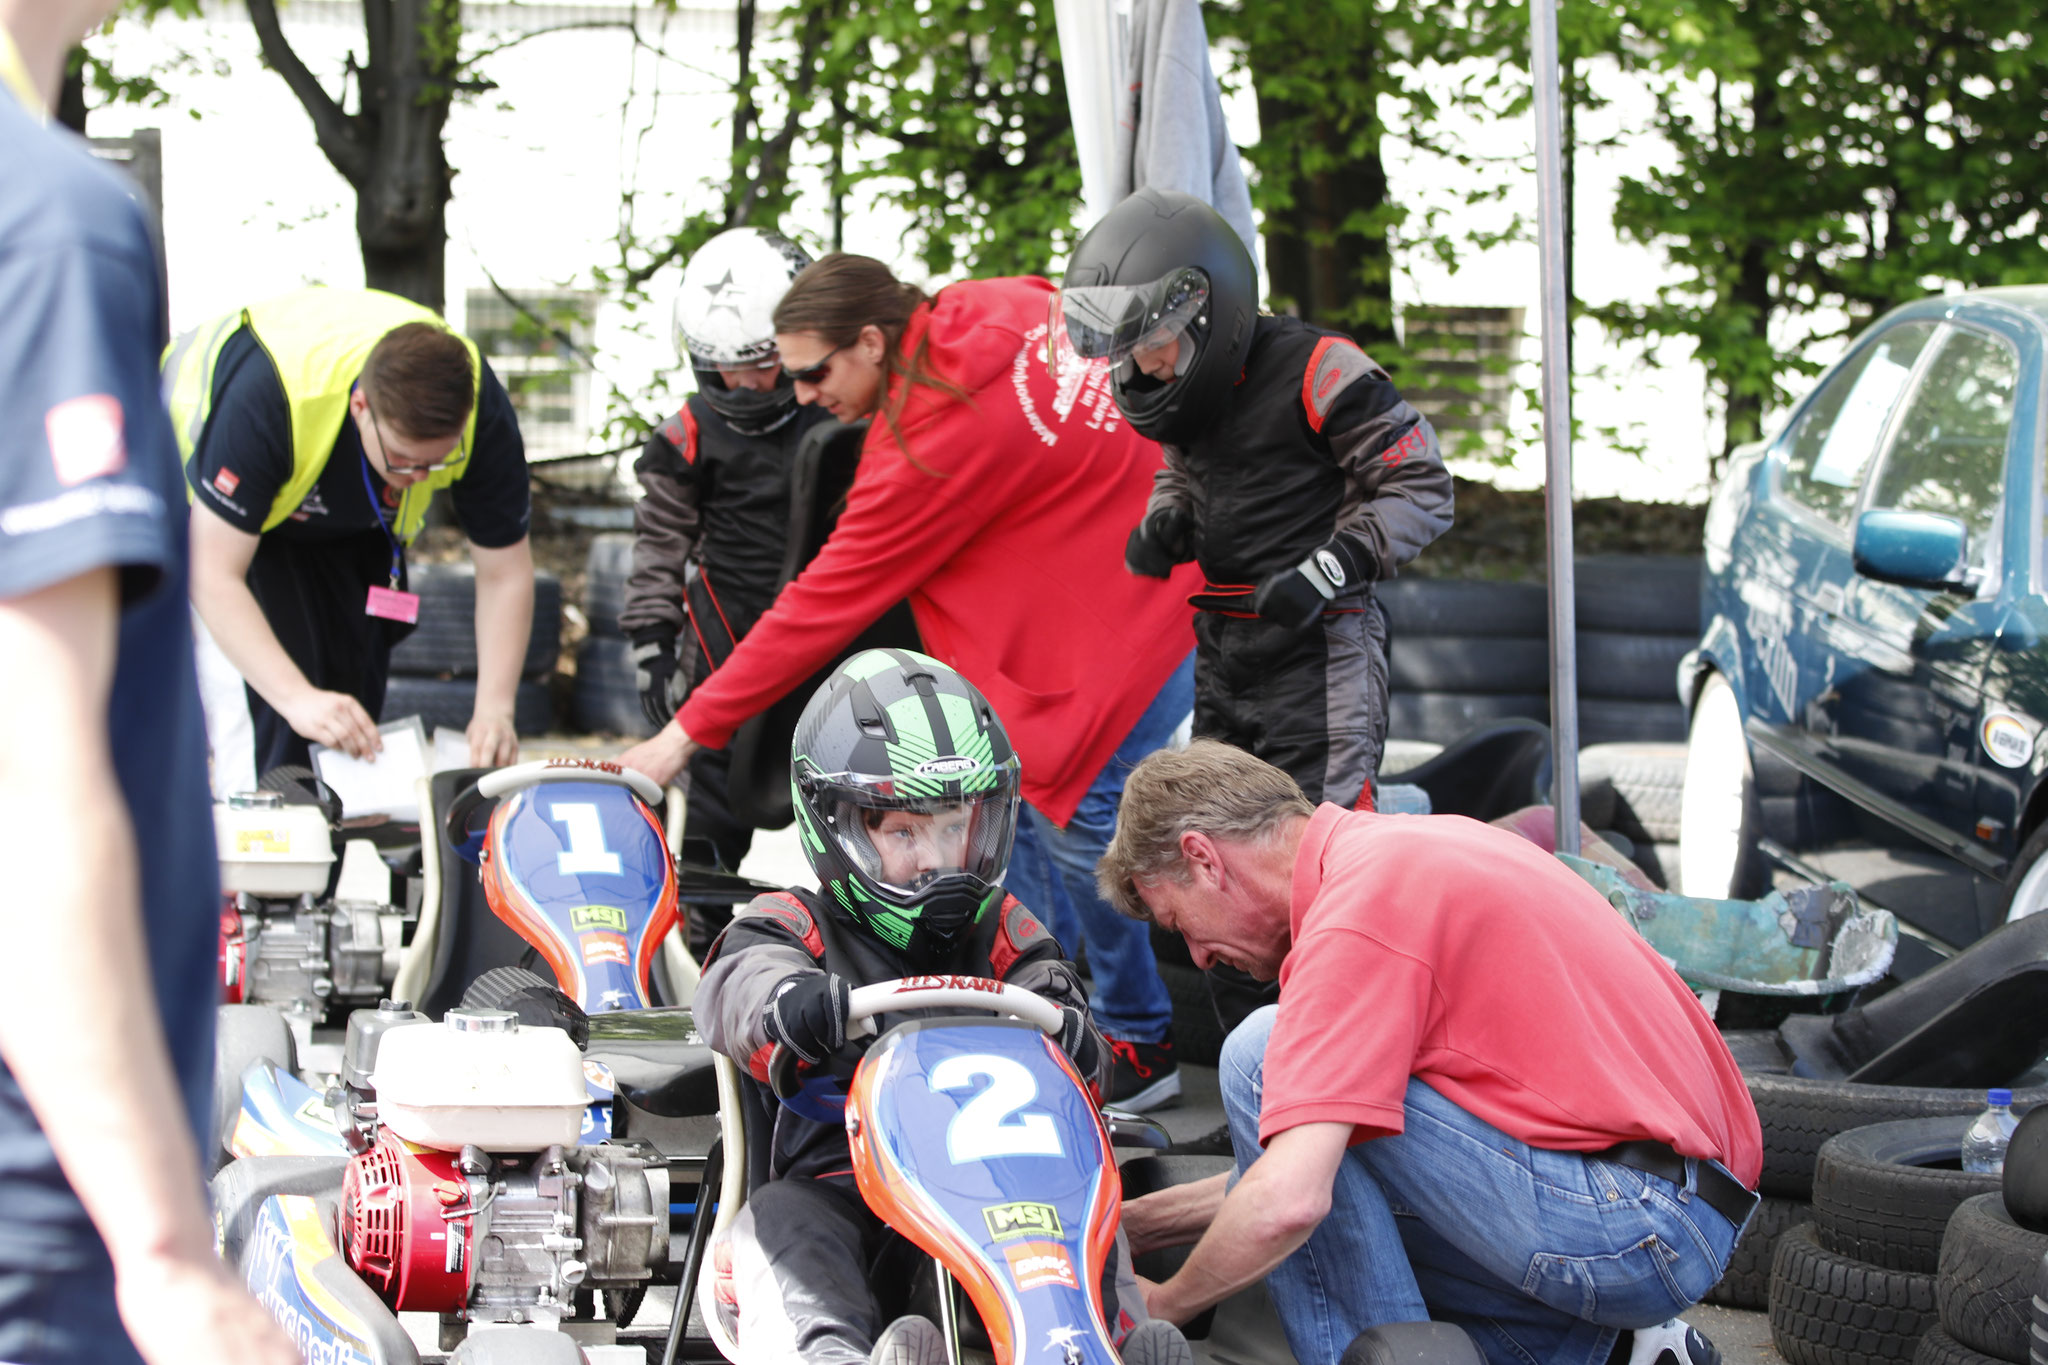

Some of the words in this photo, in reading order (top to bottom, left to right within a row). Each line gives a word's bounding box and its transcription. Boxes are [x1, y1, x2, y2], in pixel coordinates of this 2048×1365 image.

[549, 802, 624, 876] 1
[929, 1055, 1064, 1164] 2
[992, 1205, 1055, 1232] MSJ
